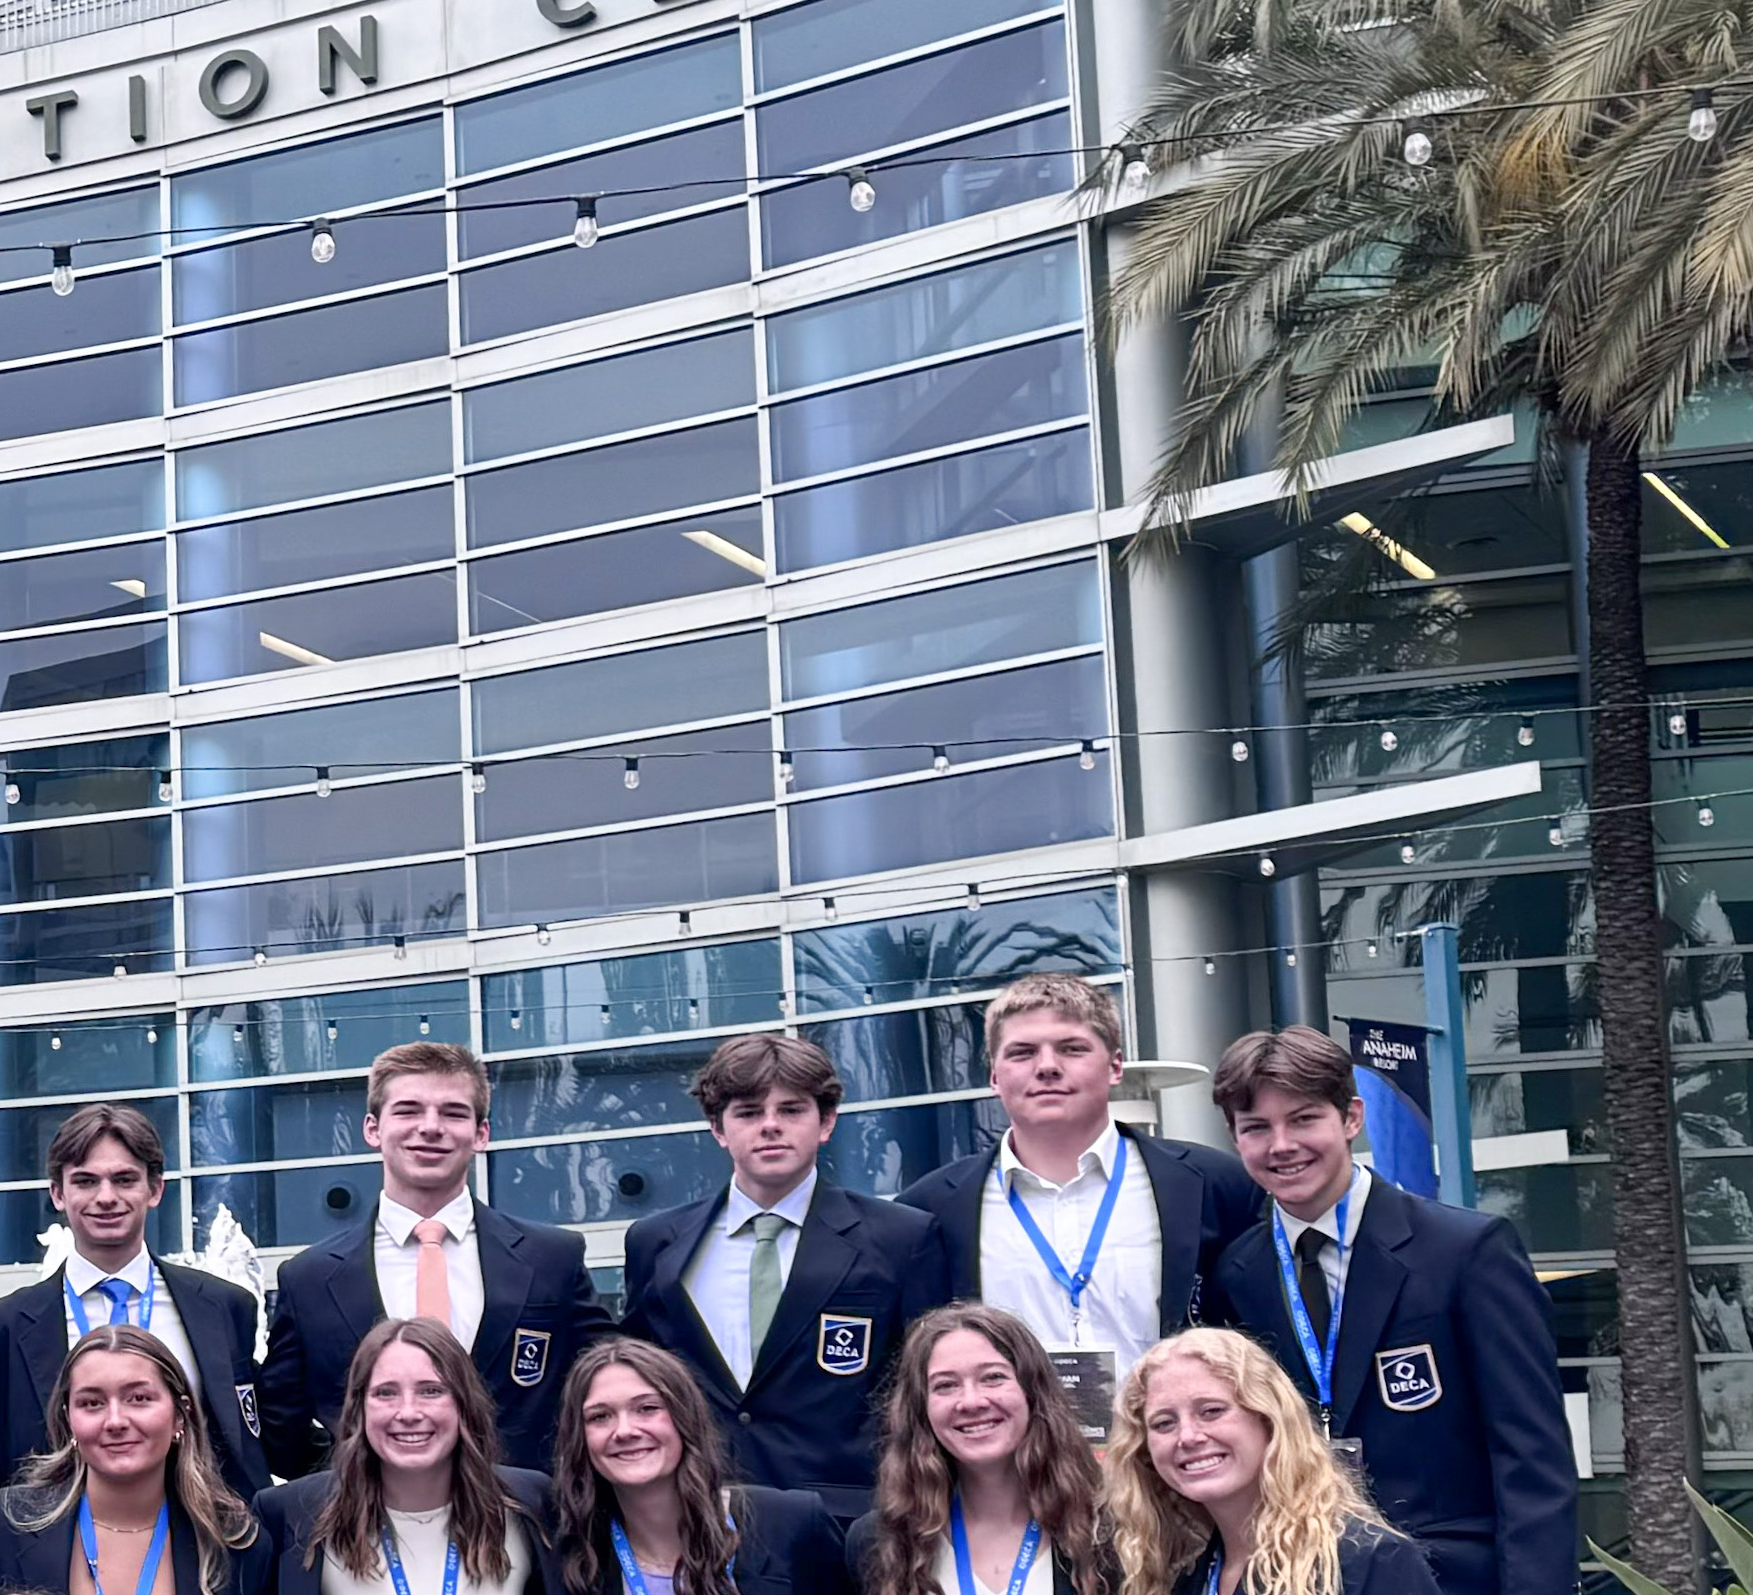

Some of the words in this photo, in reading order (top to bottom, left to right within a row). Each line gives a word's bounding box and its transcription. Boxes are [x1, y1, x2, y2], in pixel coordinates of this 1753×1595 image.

[1363, 1040, 1417, 1061] ANAHEIM
[826, 1345, 859, 1358] DECA
[1389, 1378, 1431, 1394] DECA
